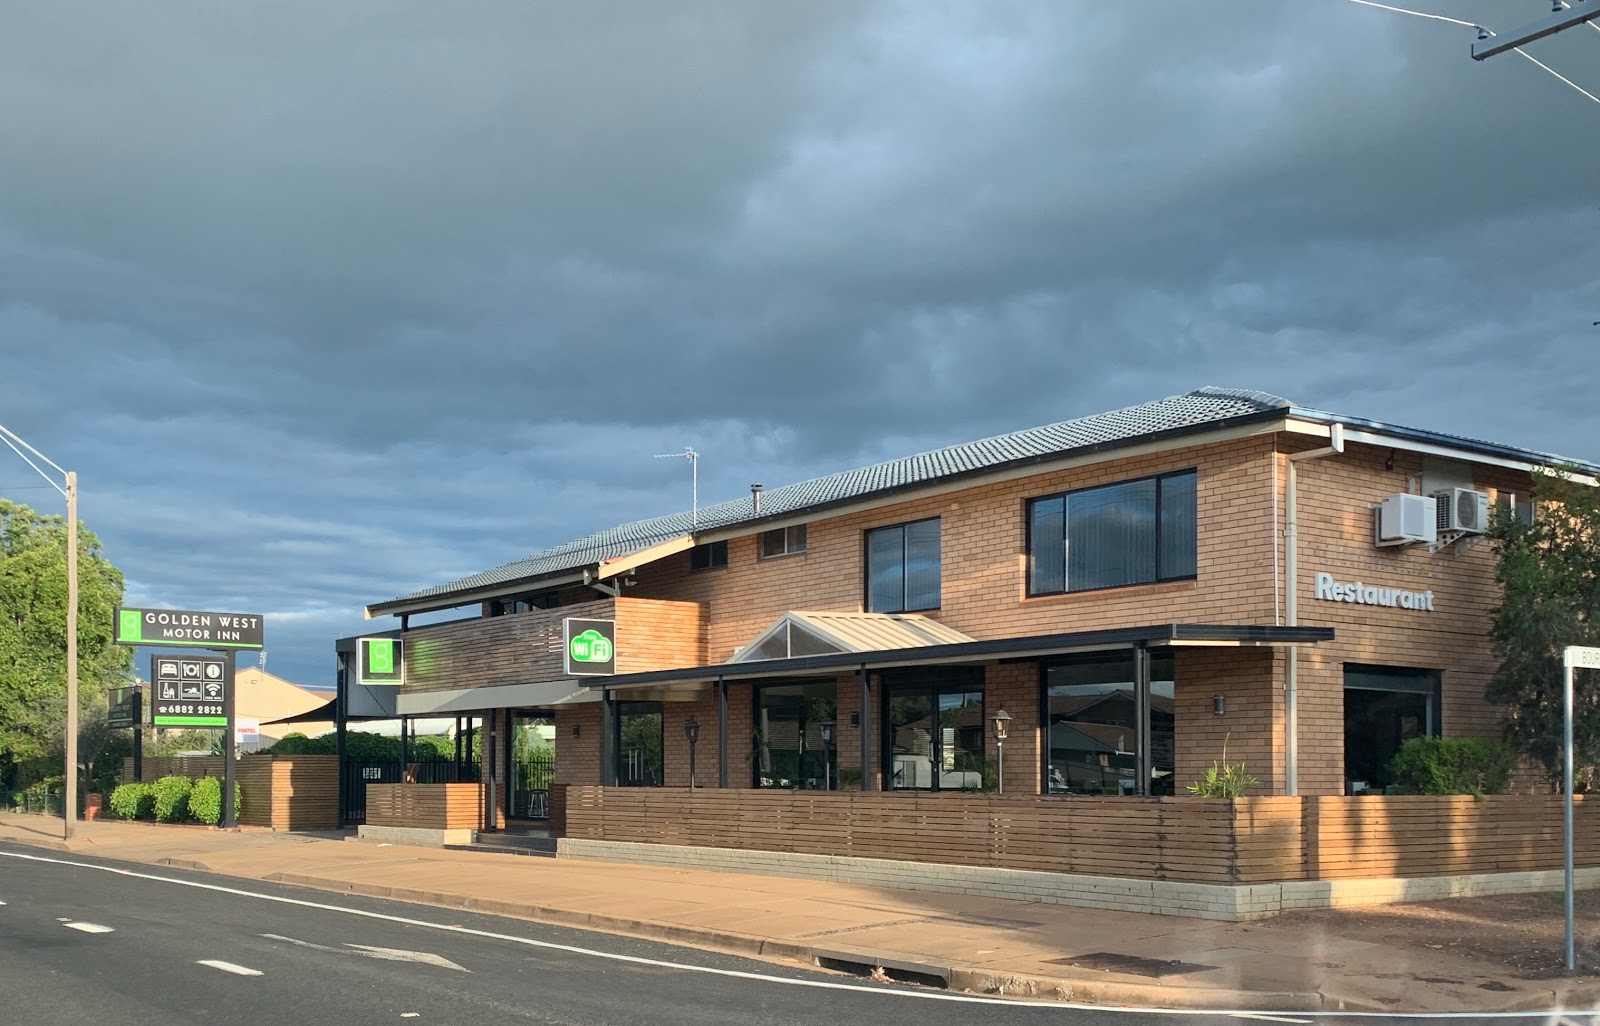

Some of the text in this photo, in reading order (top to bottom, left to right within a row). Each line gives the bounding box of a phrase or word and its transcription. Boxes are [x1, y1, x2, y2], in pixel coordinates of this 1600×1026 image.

[1315, 572, 1434, 611] Restaurant
[145, 612, 258, 629] GOLDEN WEST
[163, 628, 240, 641] MOTOR INN
[168, 704, 223, 715] 6882 2822
